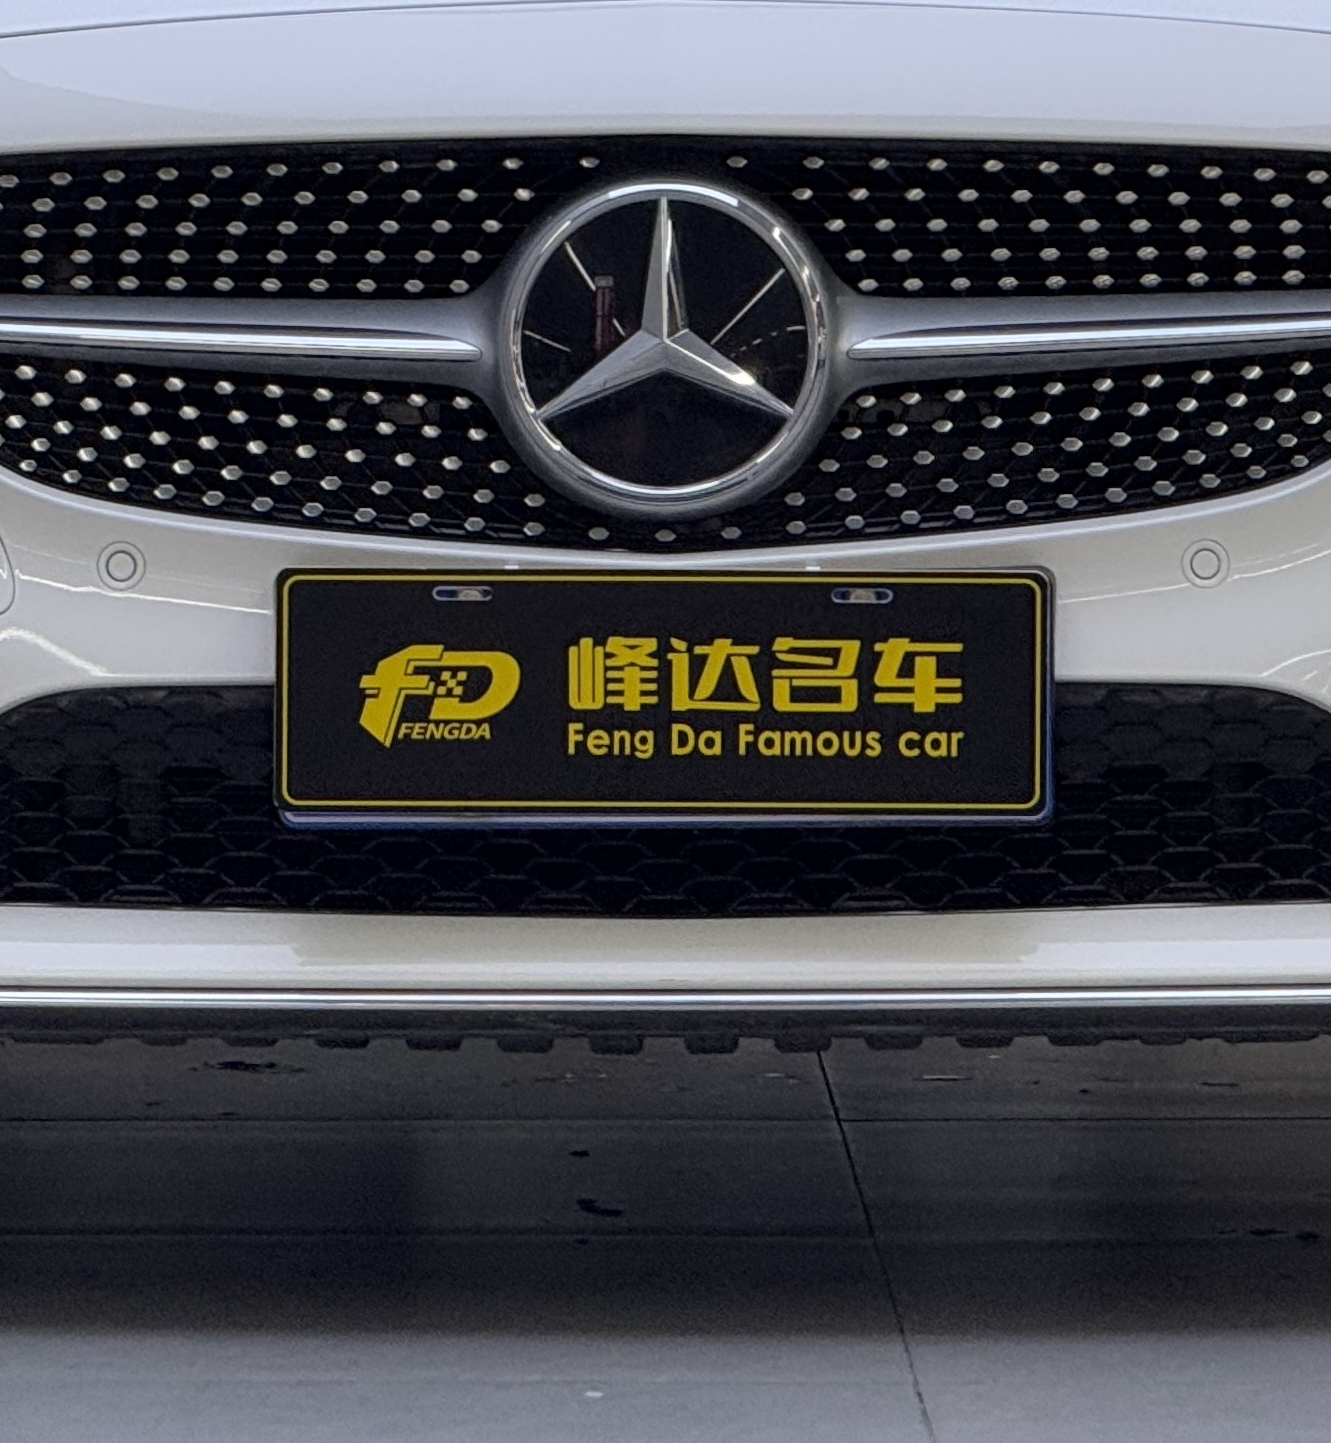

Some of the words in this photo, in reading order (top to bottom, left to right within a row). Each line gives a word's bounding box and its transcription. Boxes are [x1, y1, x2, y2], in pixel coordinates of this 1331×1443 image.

[568, 637, 963, 714] 峰达名车
[397, 722, 492, 740] FENGDA
[568, 722, 655, 760] Feng
[671, 723, 722, 756] Da
[738, 723, 882, 757] Famous
[898, 732, 963, 758] car
